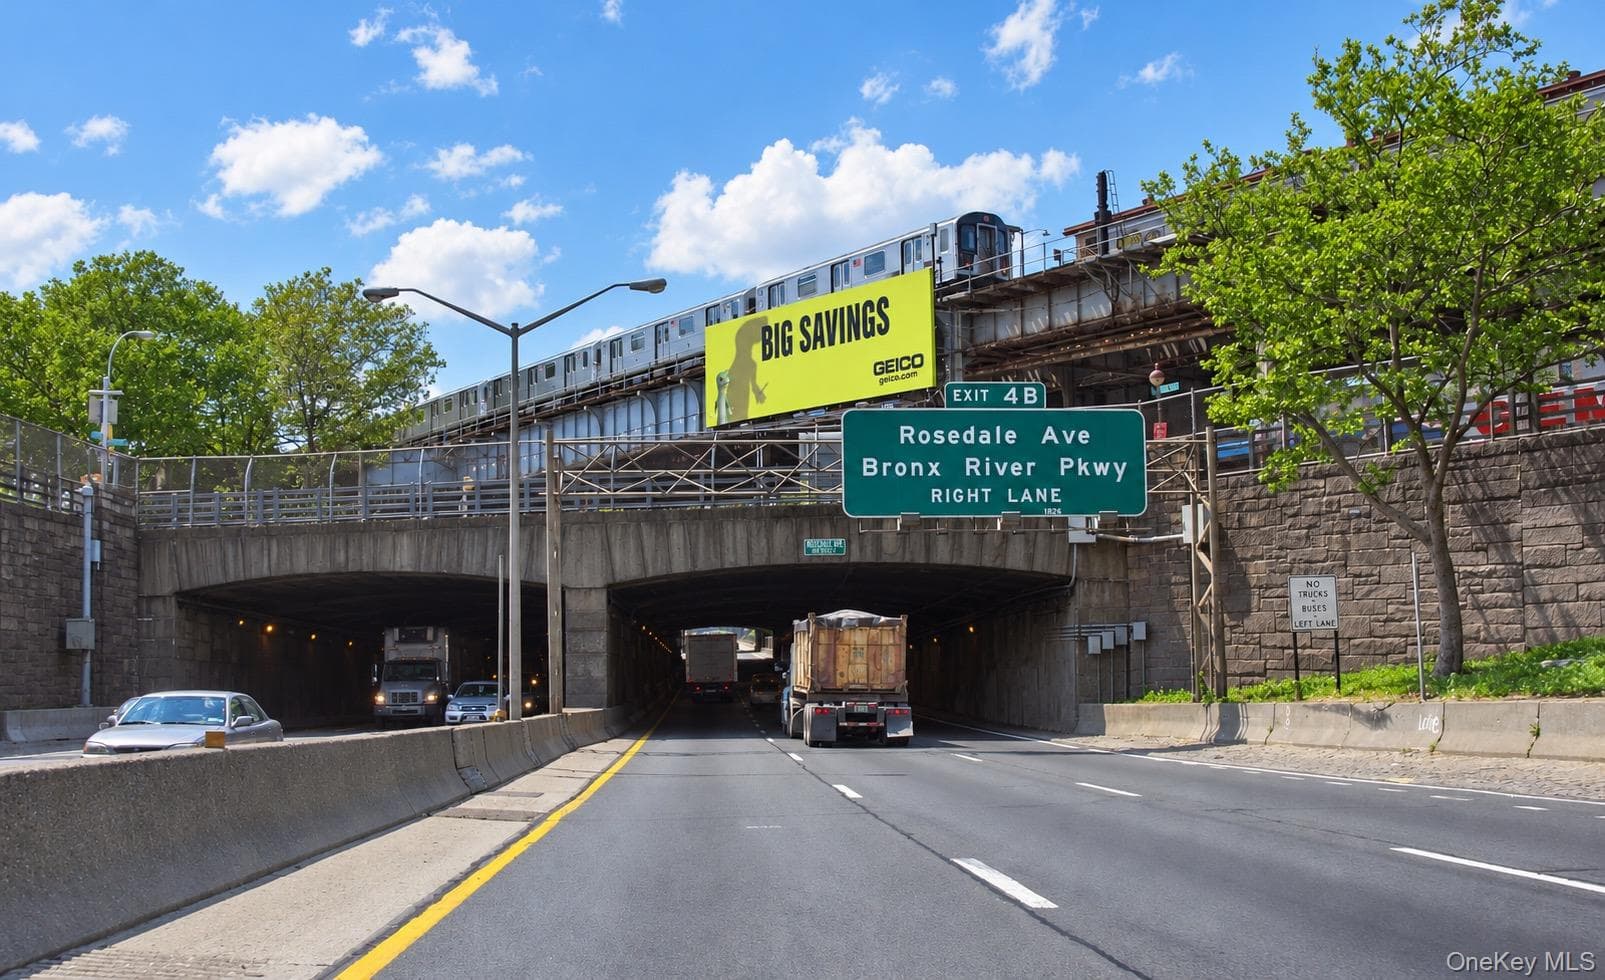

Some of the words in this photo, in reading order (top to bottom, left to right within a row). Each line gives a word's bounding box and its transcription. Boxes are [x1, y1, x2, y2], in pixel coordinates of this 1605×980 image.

[761, 320, 793, 361] BIG
[799, 296, 890, 353] SAVINGS
[873, 353, 924, 376] GEICO
[879, 371, 918, 385] geico.com
[953, 389, 989, 402] EXIT
[1003, 387, 1038, 405] 4B
[900, 425, 1017, 444] Rosedale
[1041, 425, 1090, 444] Ave
[862, 457, 941, 477] Bronx
[965, 457, 1036, 477] River
[1060, 457, 1127, 483] Pkwy
[931, 488, 992, 503] RIGHT
[1008, 488, 1062, 503] LANE
[1306, 580, 1320, 588] NO
[1294, 620, 1312, 628] LEFT
